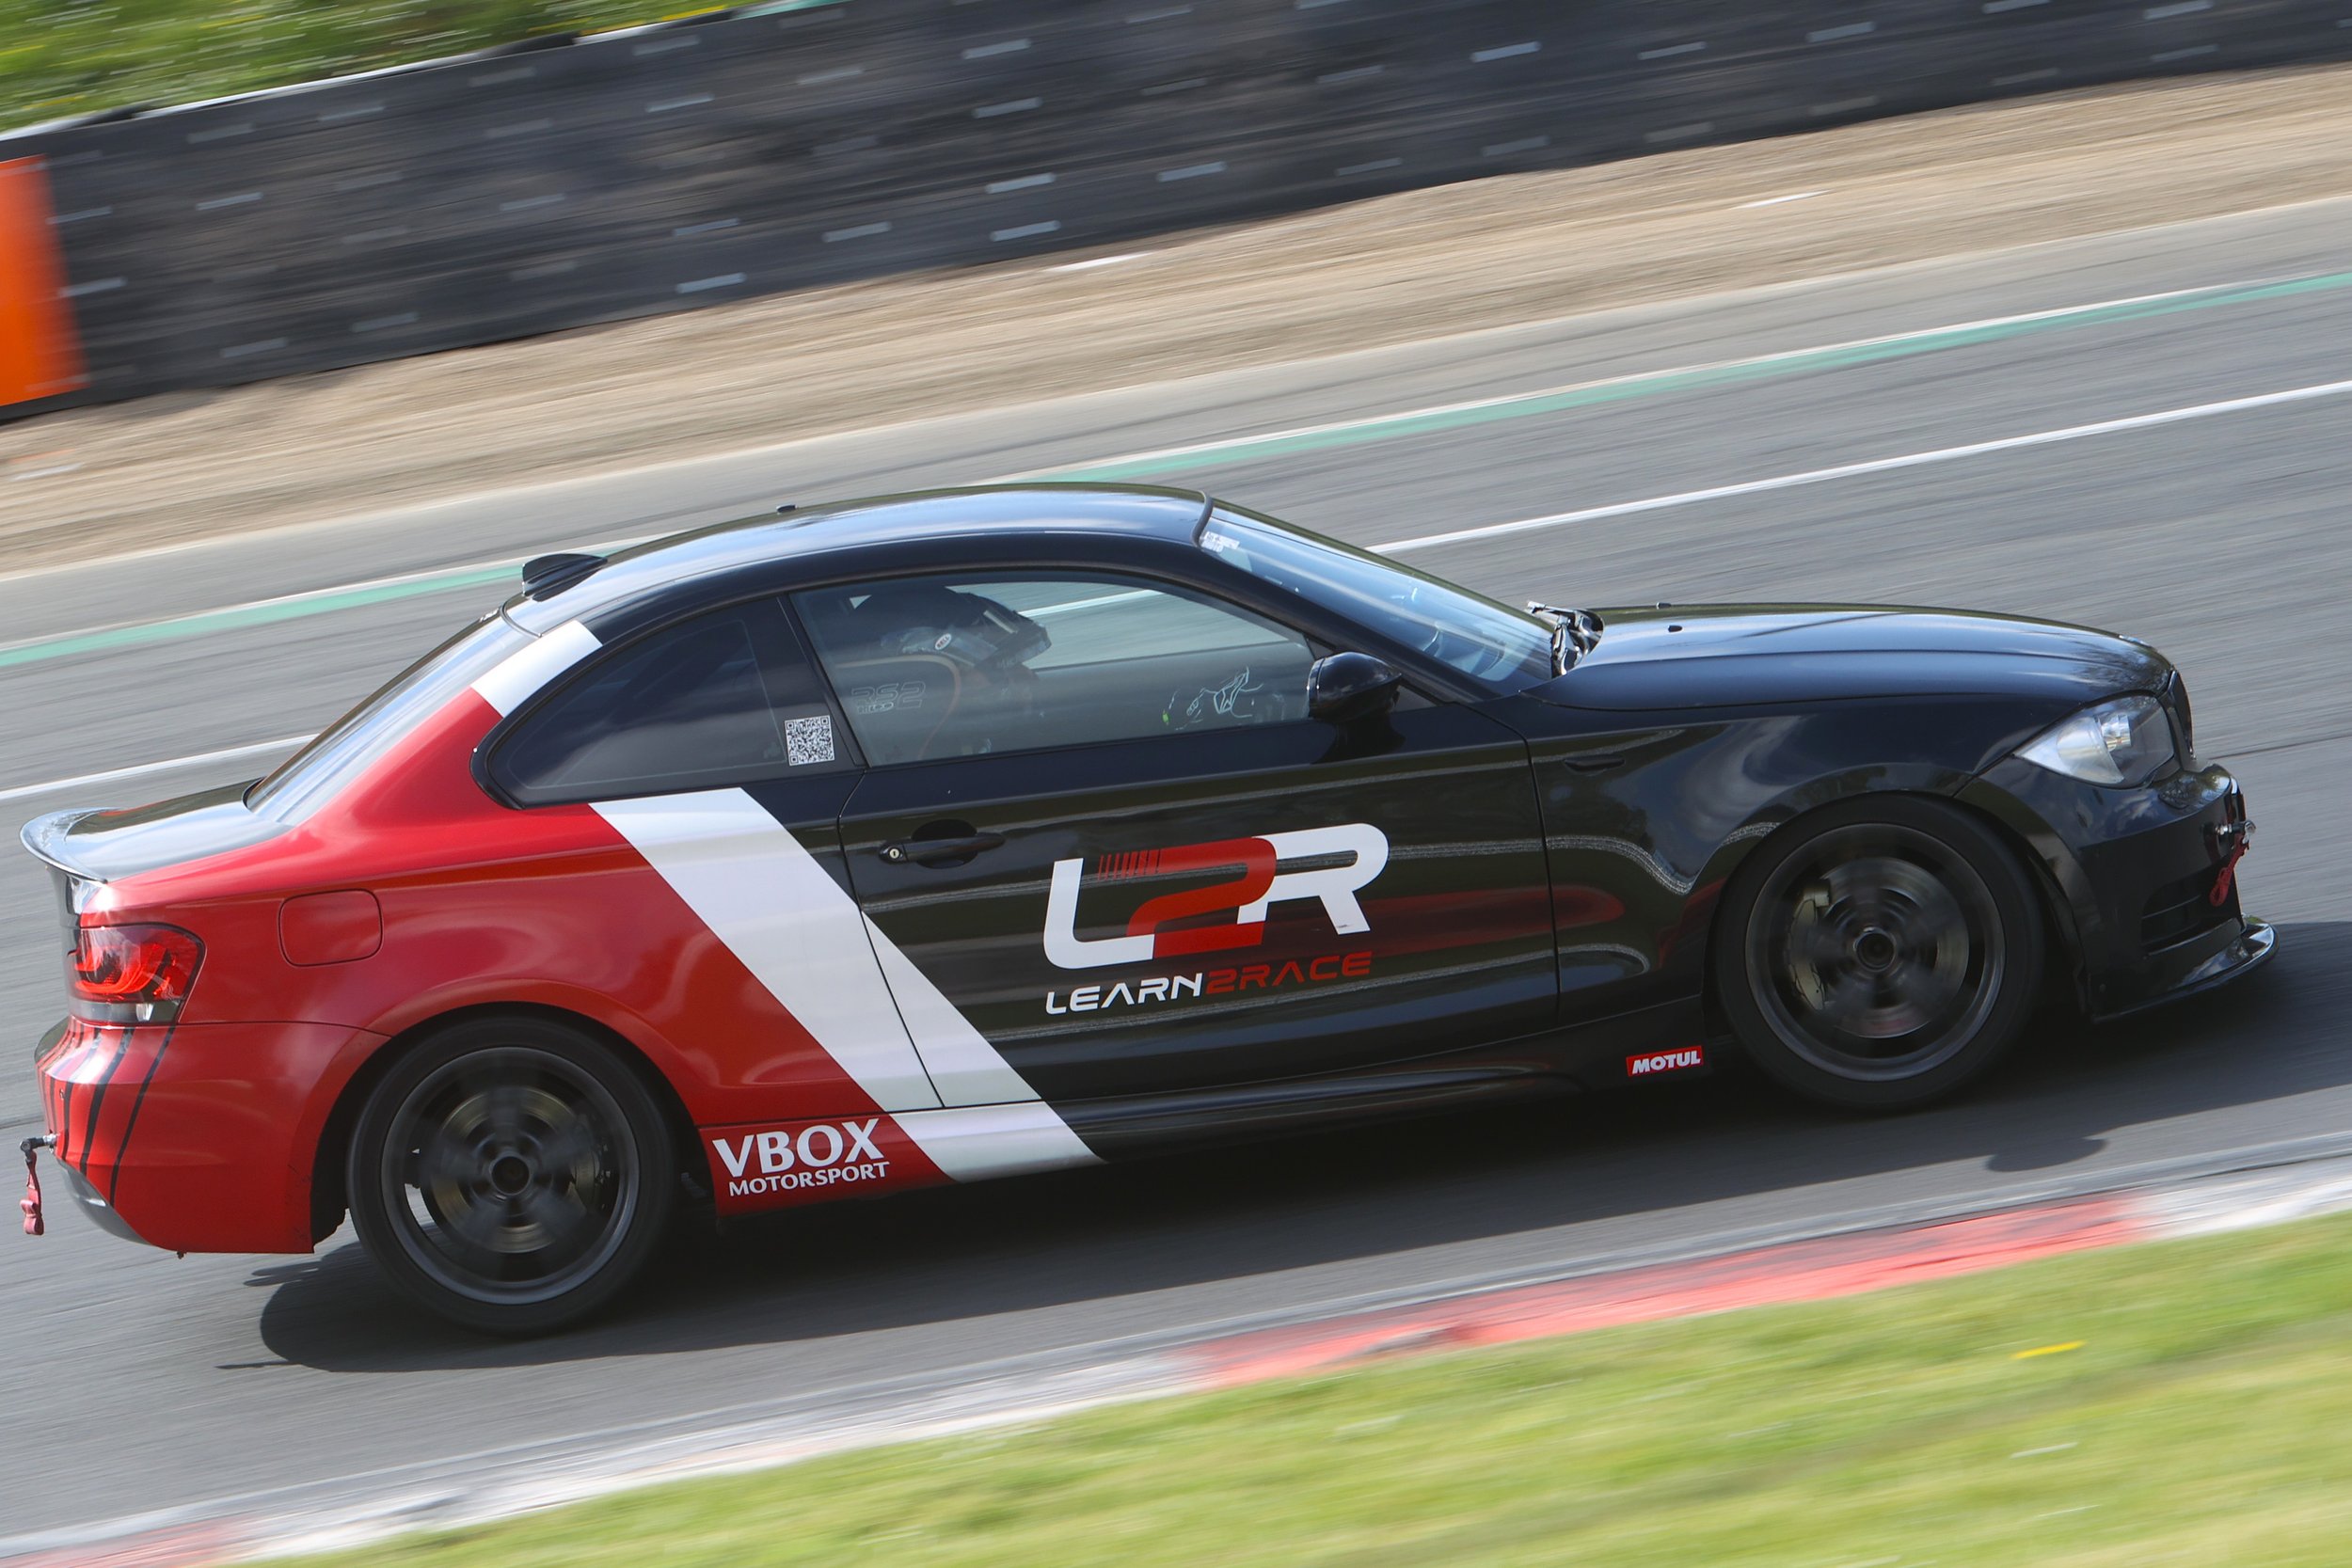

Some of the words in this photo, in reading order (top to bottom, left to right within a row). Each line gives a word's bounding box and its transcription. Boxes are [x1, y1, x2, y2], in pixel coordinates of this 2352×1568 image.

[1043, 822, 1390, 970] L2R
[1045, 951, 1373, 1015] LEARN2RACE
[1632, 1051, 1701, 1074] MOTUL
[712, 1118, 884, 1178] VBOX
[729, 1162, 890, 1196] MOTORSPORT
